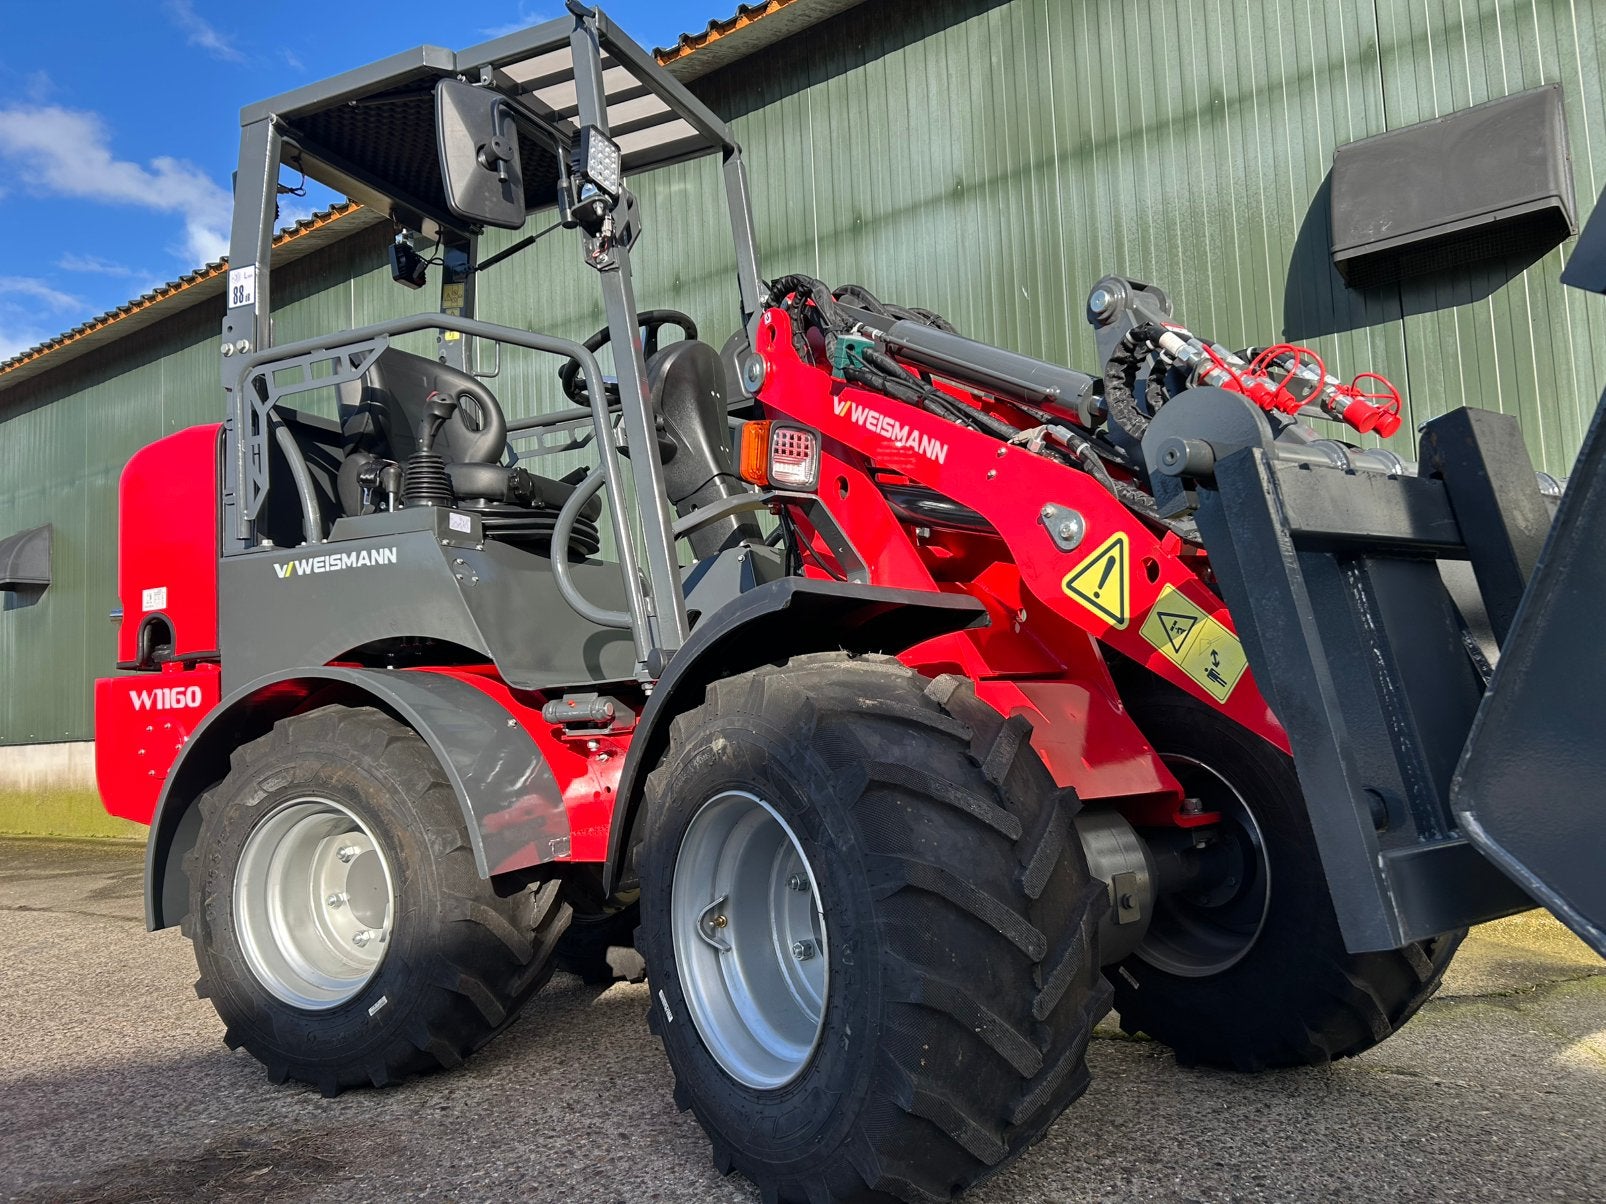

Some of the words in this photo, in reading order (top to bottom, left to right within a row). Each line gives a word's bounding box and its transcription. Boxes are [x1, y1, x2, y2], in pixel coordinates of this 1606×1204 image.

[233, 284, 244, 305] 88
[851, 402, 948, 465] WEISMANN
[294, 547, 397, 576] WEISMANN
[129, 686, 202, 711] W1160
